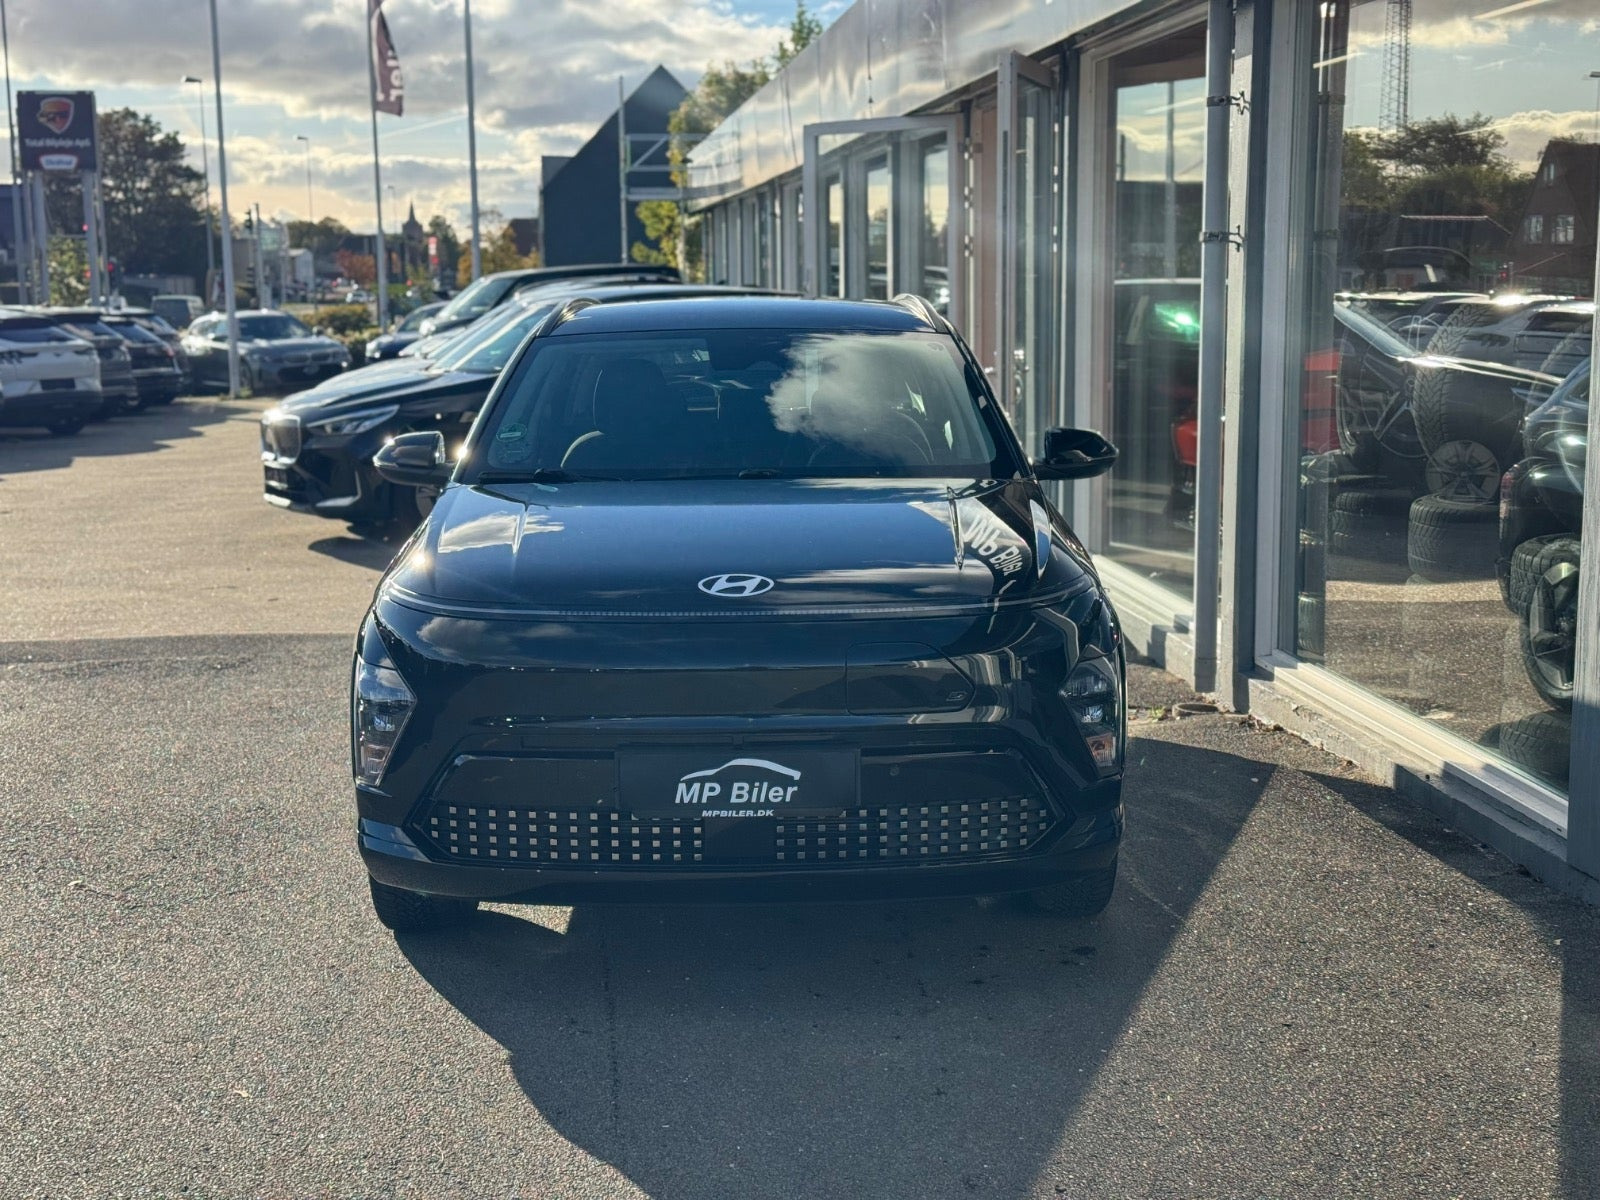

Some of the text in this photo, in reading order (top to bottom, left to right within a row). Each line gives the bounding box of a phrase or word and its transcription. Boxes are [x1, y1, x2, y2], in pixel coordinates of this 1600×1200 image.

[674, 781, 799, 804] MP Biler
[701, 809, 775, 818] MPBILER.DK
